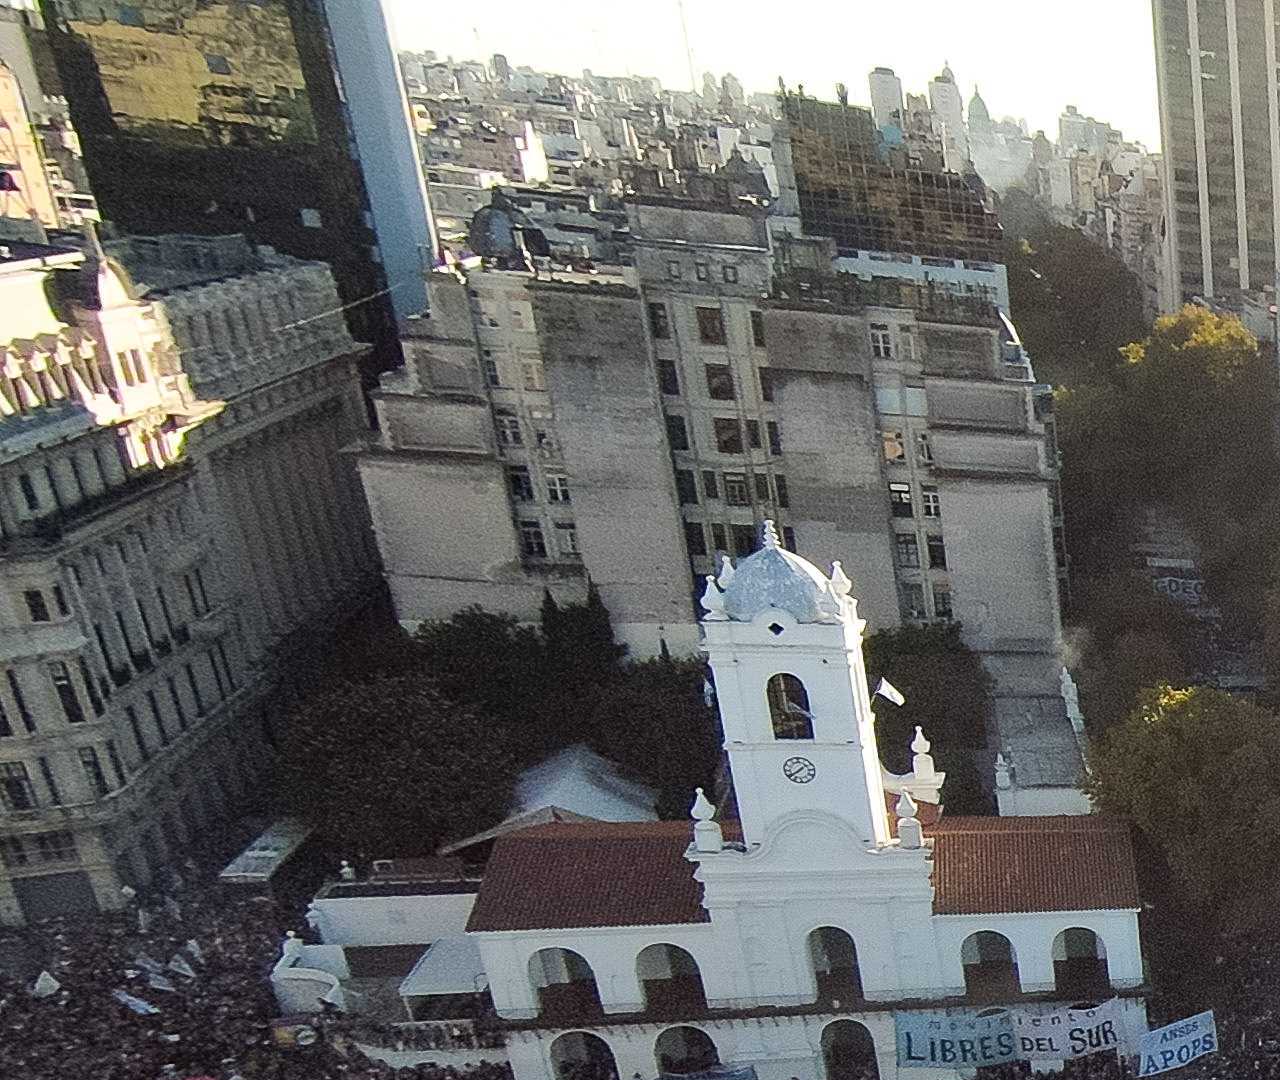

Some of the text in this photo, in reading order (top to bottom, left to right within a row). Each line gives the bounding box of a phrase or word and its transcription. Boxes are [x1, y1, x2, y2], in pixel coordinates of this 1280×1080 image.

[1020, 1036, 1061, 1052] DEL
[1069, 1019, 1119, 1054] SUR
[1143, 1033, 1216, 1076] APOPS
